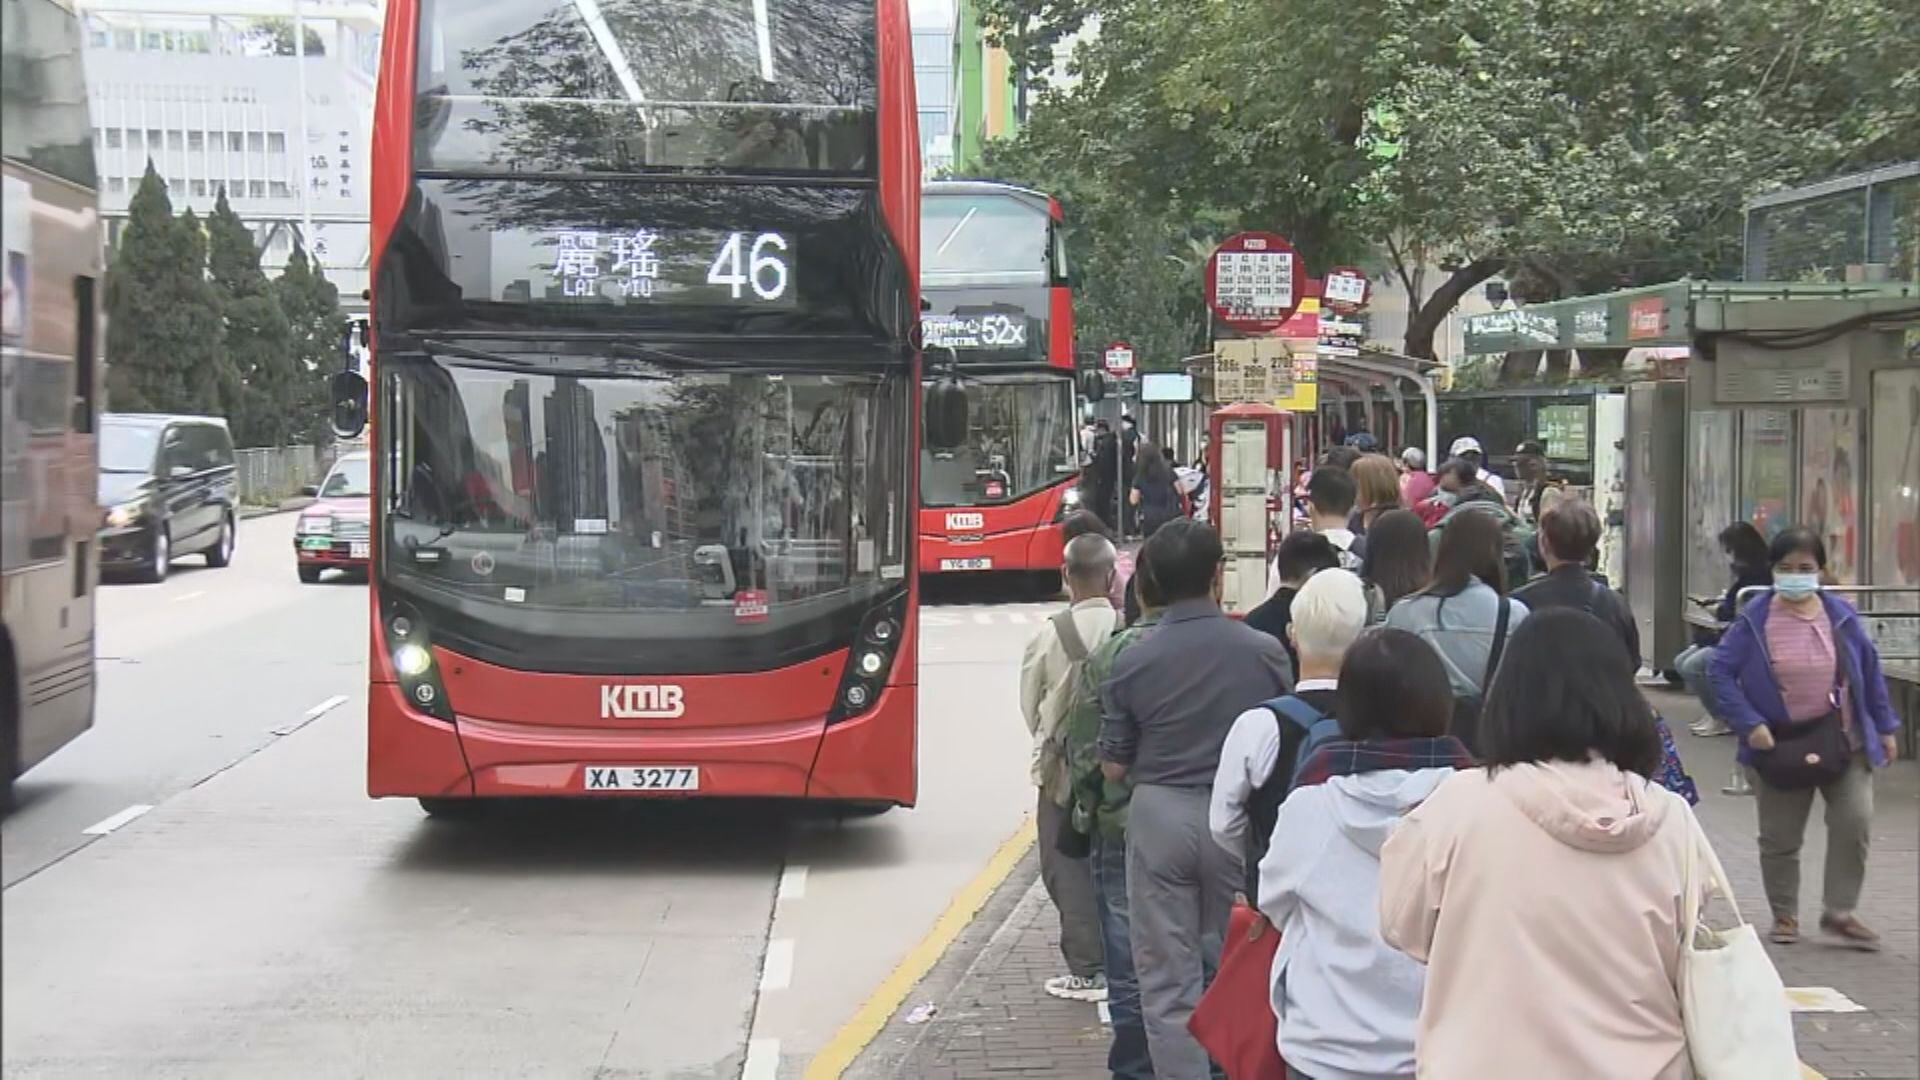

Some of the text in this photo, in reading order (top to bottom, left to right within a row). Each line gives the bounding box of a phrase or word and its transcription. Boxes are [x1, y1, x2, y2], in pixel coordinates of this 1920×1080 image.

[707, 232, 787, 299] 46
[563, 277, 596, 297] LAI
[945, 512, 984, 530] KMB
[600, 684, 686, 718] KMB
[590, 768, 693, 788] XA 3277
